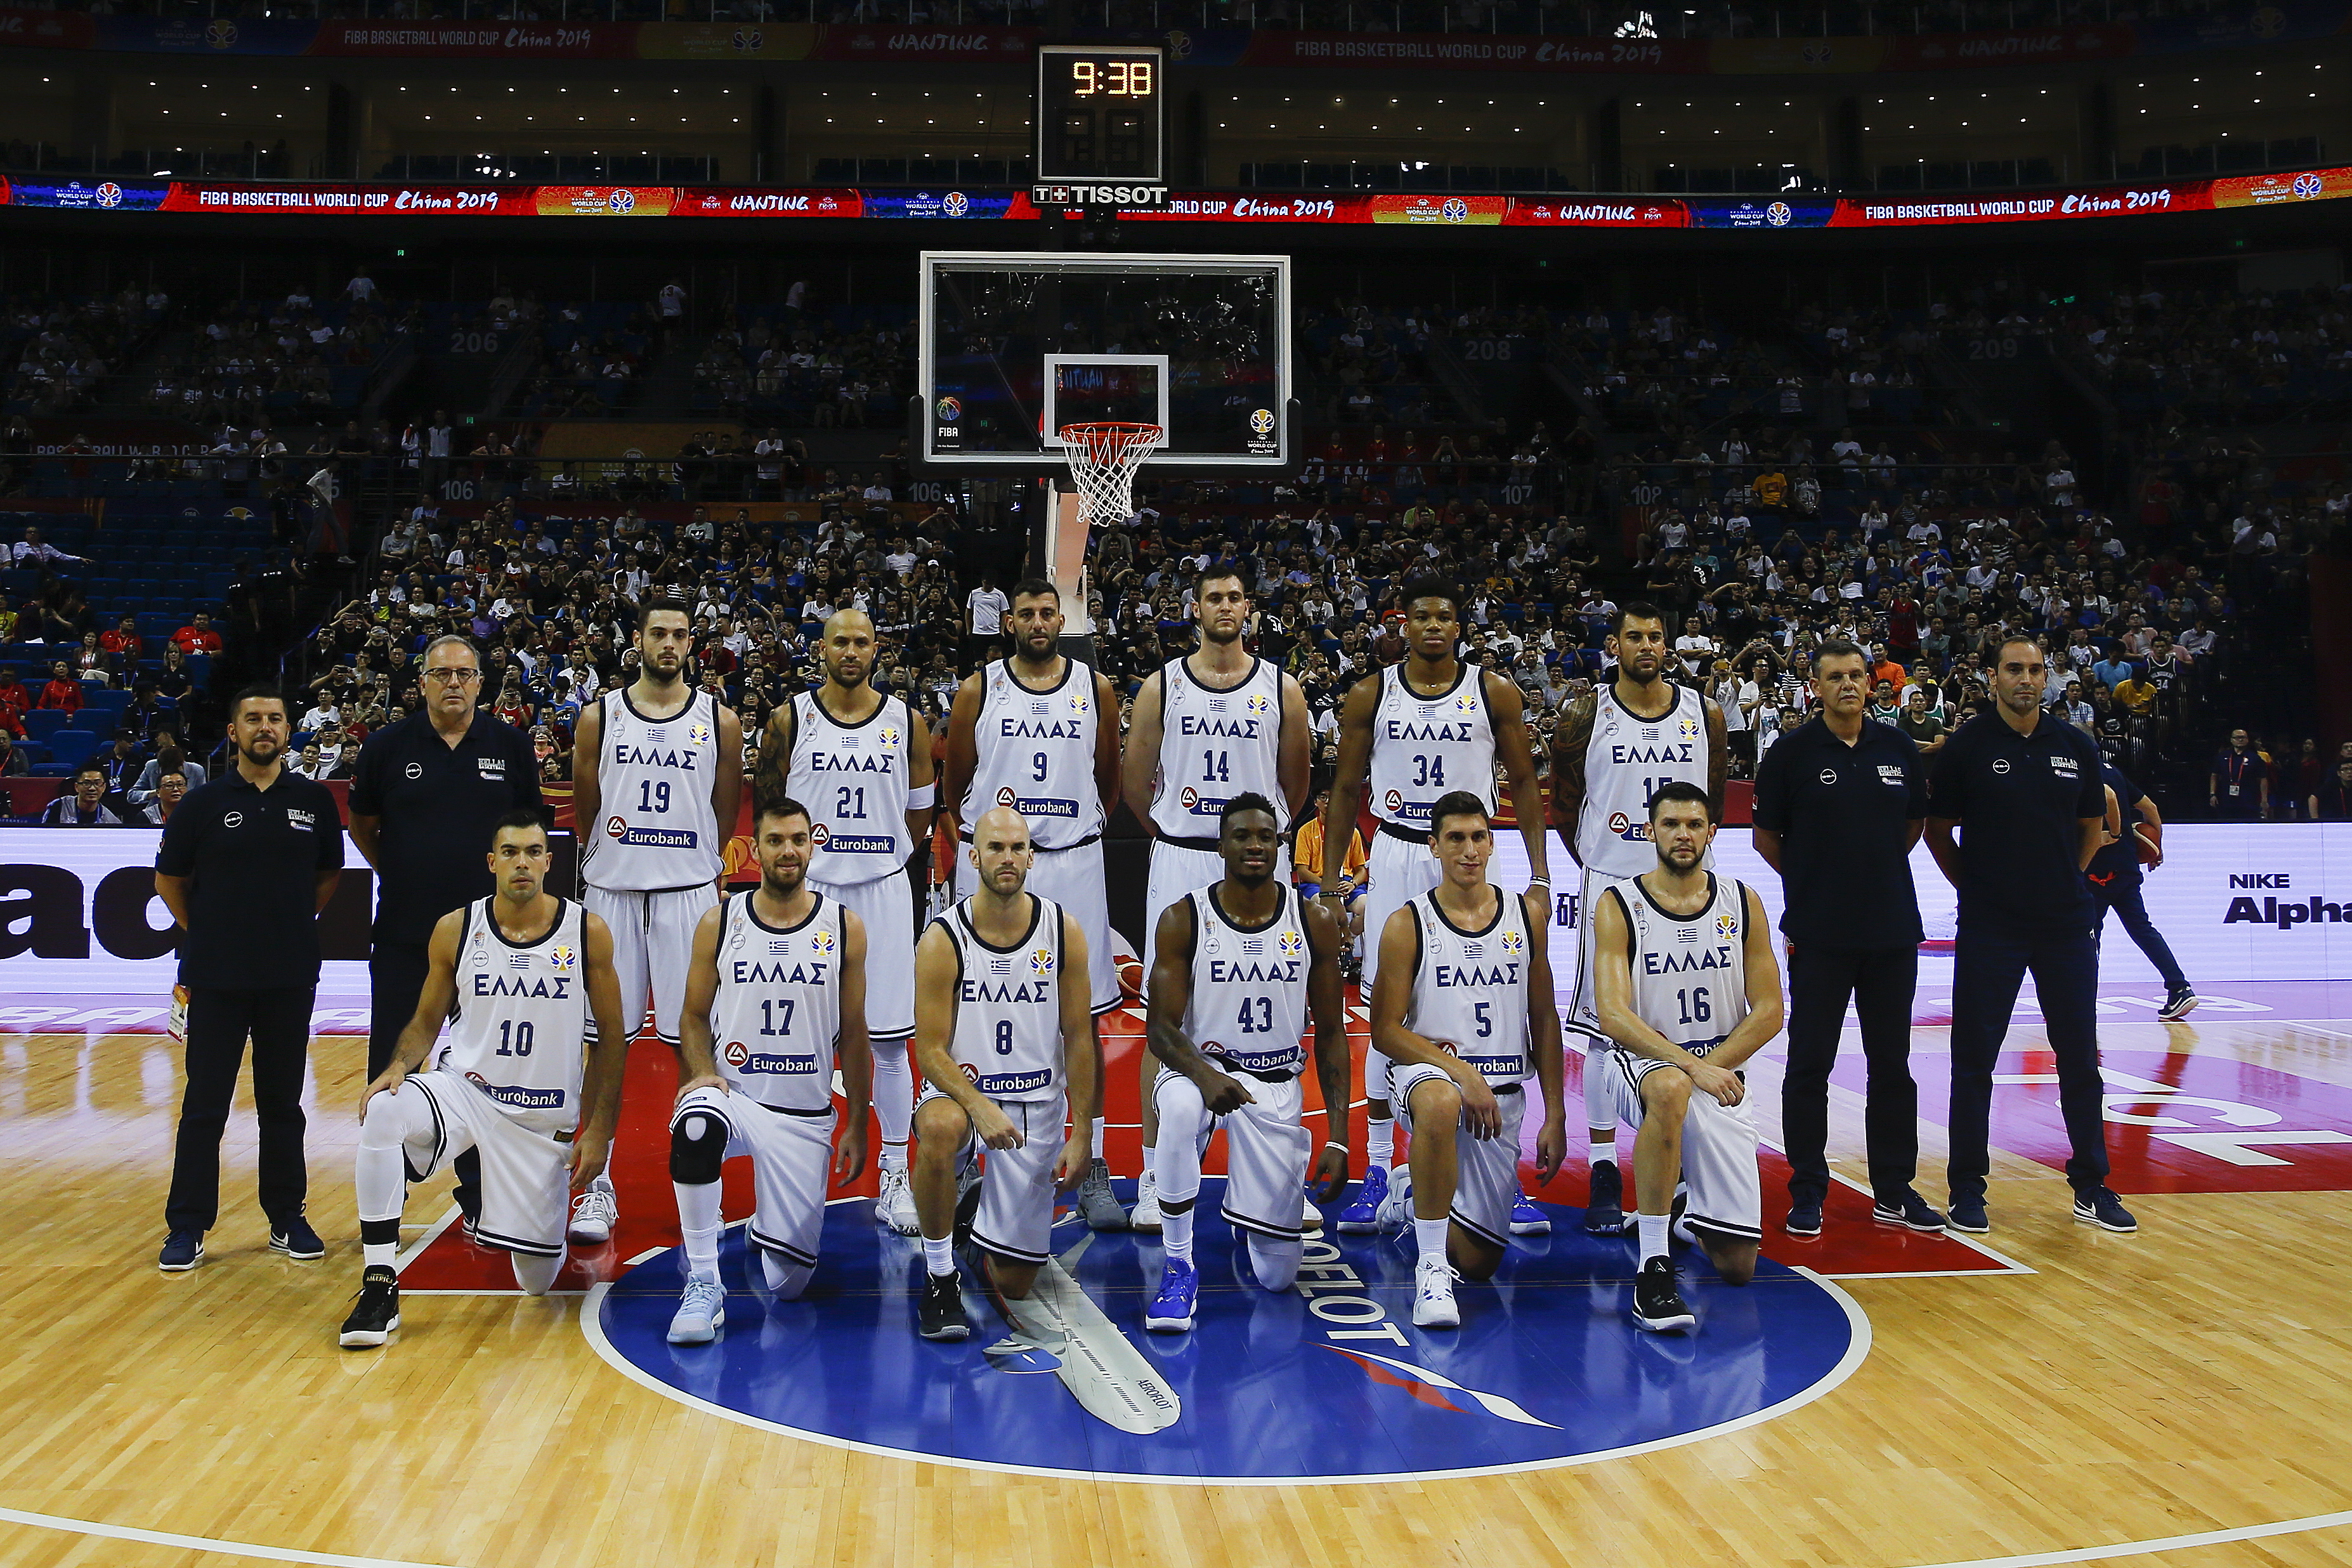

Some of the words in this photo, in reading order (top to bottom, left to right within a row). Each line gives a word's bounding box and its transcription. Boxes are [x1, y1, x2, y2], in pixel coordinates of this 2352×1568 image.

[344, 30, 368, 44] FIBA
[371, 30, 436, 45] BASKETBALL
[439, 31, 475, 45] WORLD
[479, 31, 499, 45] CUP
[557, 29, 591, 49] 2019
[1296, 42, 1330, 56] FIBA
[1335, 42, 1434, 58] BASKETBALL
[1437, 44, 1491, 59] WORLD
[1497, 44, 1526, 60] CUP
[1073, 62, 1151, 95] 9:38
[200, 192, 228, 204] FIBA
[232, 192, 311, 206] BASKETBALL
[314, 193, 360, 207] WORLD
[364, 194, 388, 207] CUP
[395, 191, 451, 209] China
[456, 192, 499, 211] 2019
[1071, 186, 1167, 203] TISSOT
[1865, 206, 1893, 219] FIBA
[1897, 204, 1978, 218] BASKETBALL
[1980, 201, 2024, 216] WORLD
[2029, 199, 2054, 213] CUP
[2061, 195, 2120, 214] China
[2126, 189, 2171, 210] 2019
[1160, 200, 1199, 214] ORLD
[1203, 201, 1227, 214] CUP
[1232, 199, 1288, 217] China
[1293, 199, 1335, 218] 2019
[450, 333, 498, 353] 206
[1465, 340, 1511, 361] 208
[1969, 337, 2018, 360] 209
[939, 427, 958, 437] FIBA
[440, 481, 473, 500] 106
[908, 483, 941, 502] 106
[1501, 485, 1532, 505] 107
[2156, 679, 2167, 689] 34
[1000, 718, 1082, 739] ΕΛΛΑΣ
[1181, 715, 1259, 740] ΕΛΛΑΣ
[1387, 721, 1472, 742] ΕΛΛΑΣ
[615, 744, 698, 771] ΕΛΛΑΣ
[811, 752, 894, 774] ΕΛΛΑΣ
[1612, 743, 1693, 764] ΕΛΛΑΣ
[1033, 752, 1048, 782] 9
[1203, 750, 1229, 783] 14
[1412, 755, 1444, 787] 34
[637, 779, 671, 813] 19
[836, 786, 868, 819] 21
[1019, 800, 1073, 815] Eurobank
[628, 832, 691, 847] Eurobank
[832, 838, 890, 852] Eurobank
[2230, 873, 2289, 888] NIKE
[1210, 960, 1300, 983] ΕΛΛΑΣ
[1644, 945, 1732, 975] ΕΛΛΑΣ
[733, 961, 826, 986] ΕΛΛΑΣ
[1435, 964, 1519, 988] ΕΛΛΑΣ
[474, 974, 570, 999] ΕΛΛΑΣ
[961, 980, 1050, 1003] ΕΛΛΑΣ
[1238, 996, 1272, 1033] 43
[1676, 987, 1710, 1024] 16
[760, 999, 794, 1036] 17
[1474, 1002, 1492, 1038] 5
[495, 1019, 534, 1057] 10
[995, 1019, 1012, 1055] 8
[983, 1073, 1047, 1090] Eurobank
[490, 1087, 557, 1106] Eurobank
[1135, 1378, 1173, 1410] AEROFLOT
